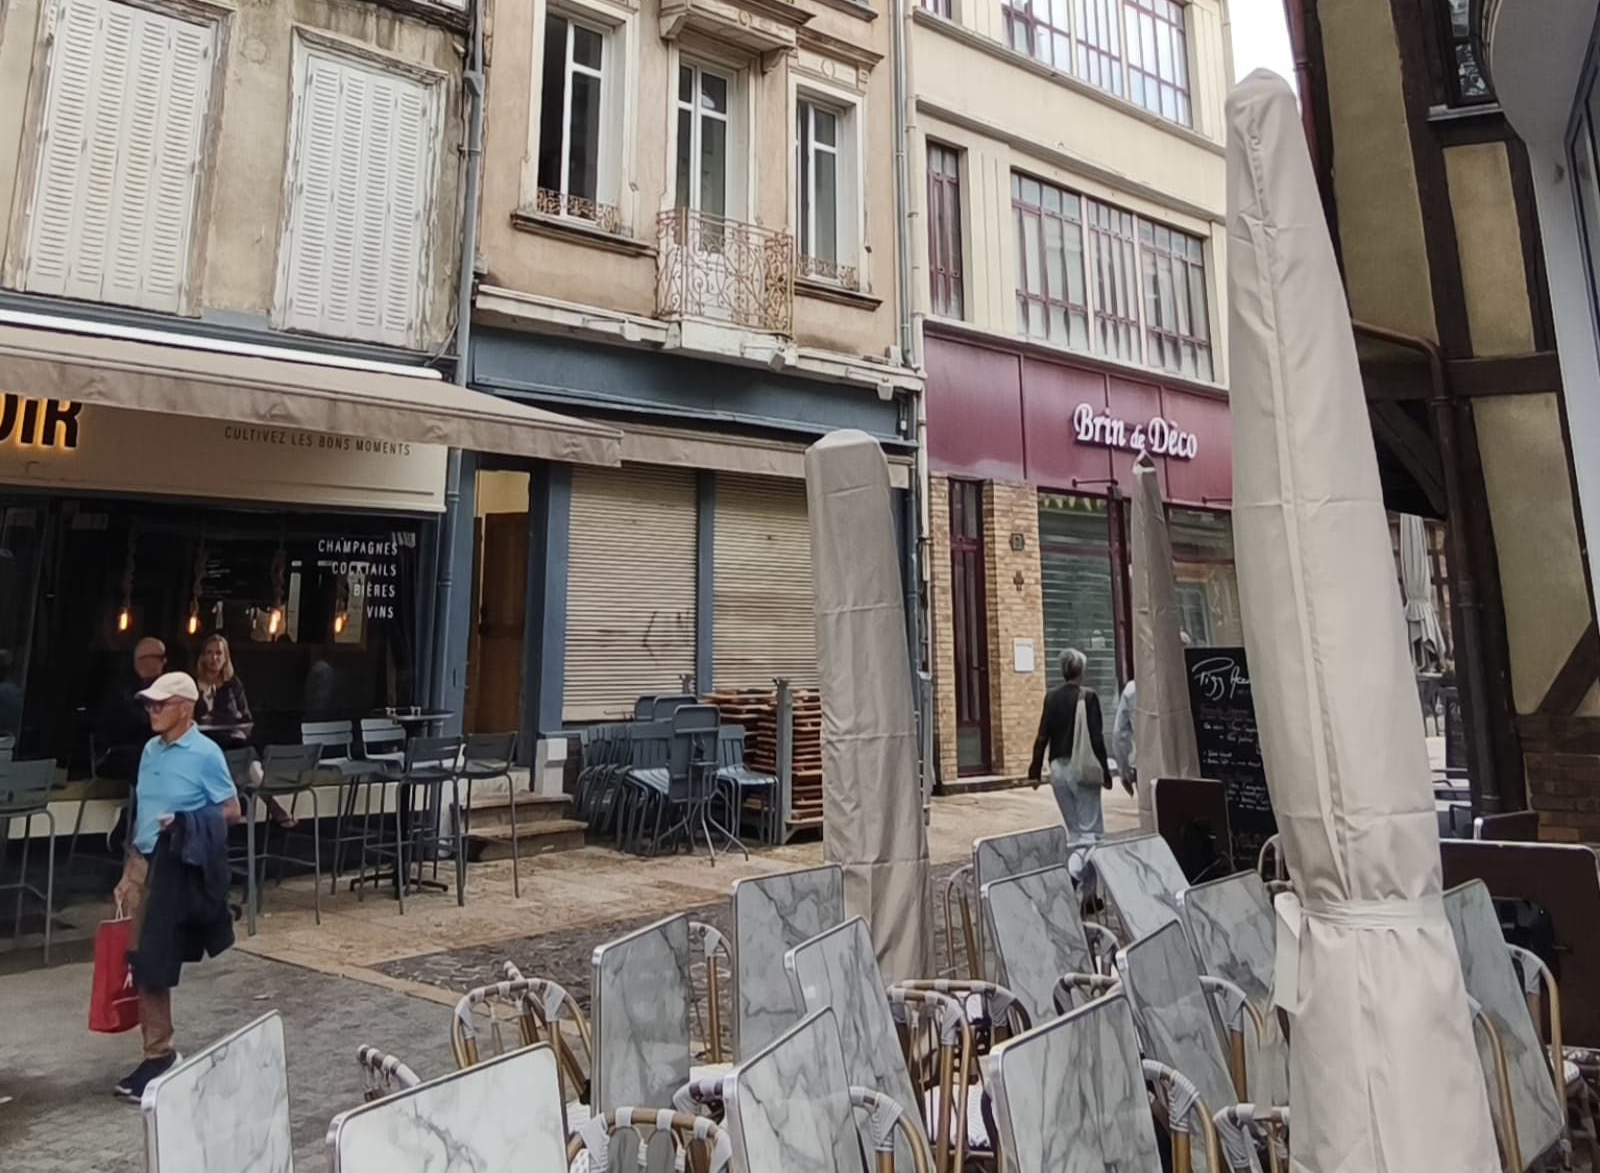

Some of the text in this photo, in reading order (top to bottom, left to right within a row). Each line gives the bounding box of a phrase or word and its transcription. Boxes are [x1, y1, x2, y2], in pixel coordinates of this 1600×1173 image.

[1074, 403, 1126, 447] Brin
[1130, 424, 1145, 448] de
[224, 426, 411, 456] CULTIVEZ LES BONS MOMENTS
[318, 540, 398, 556] CHAMPAGNES
[332, 561, 397, 577] COCKTAILS
[353, 581, 396, 598] BIÈRES
[366, 605, 395, 619] VINS
